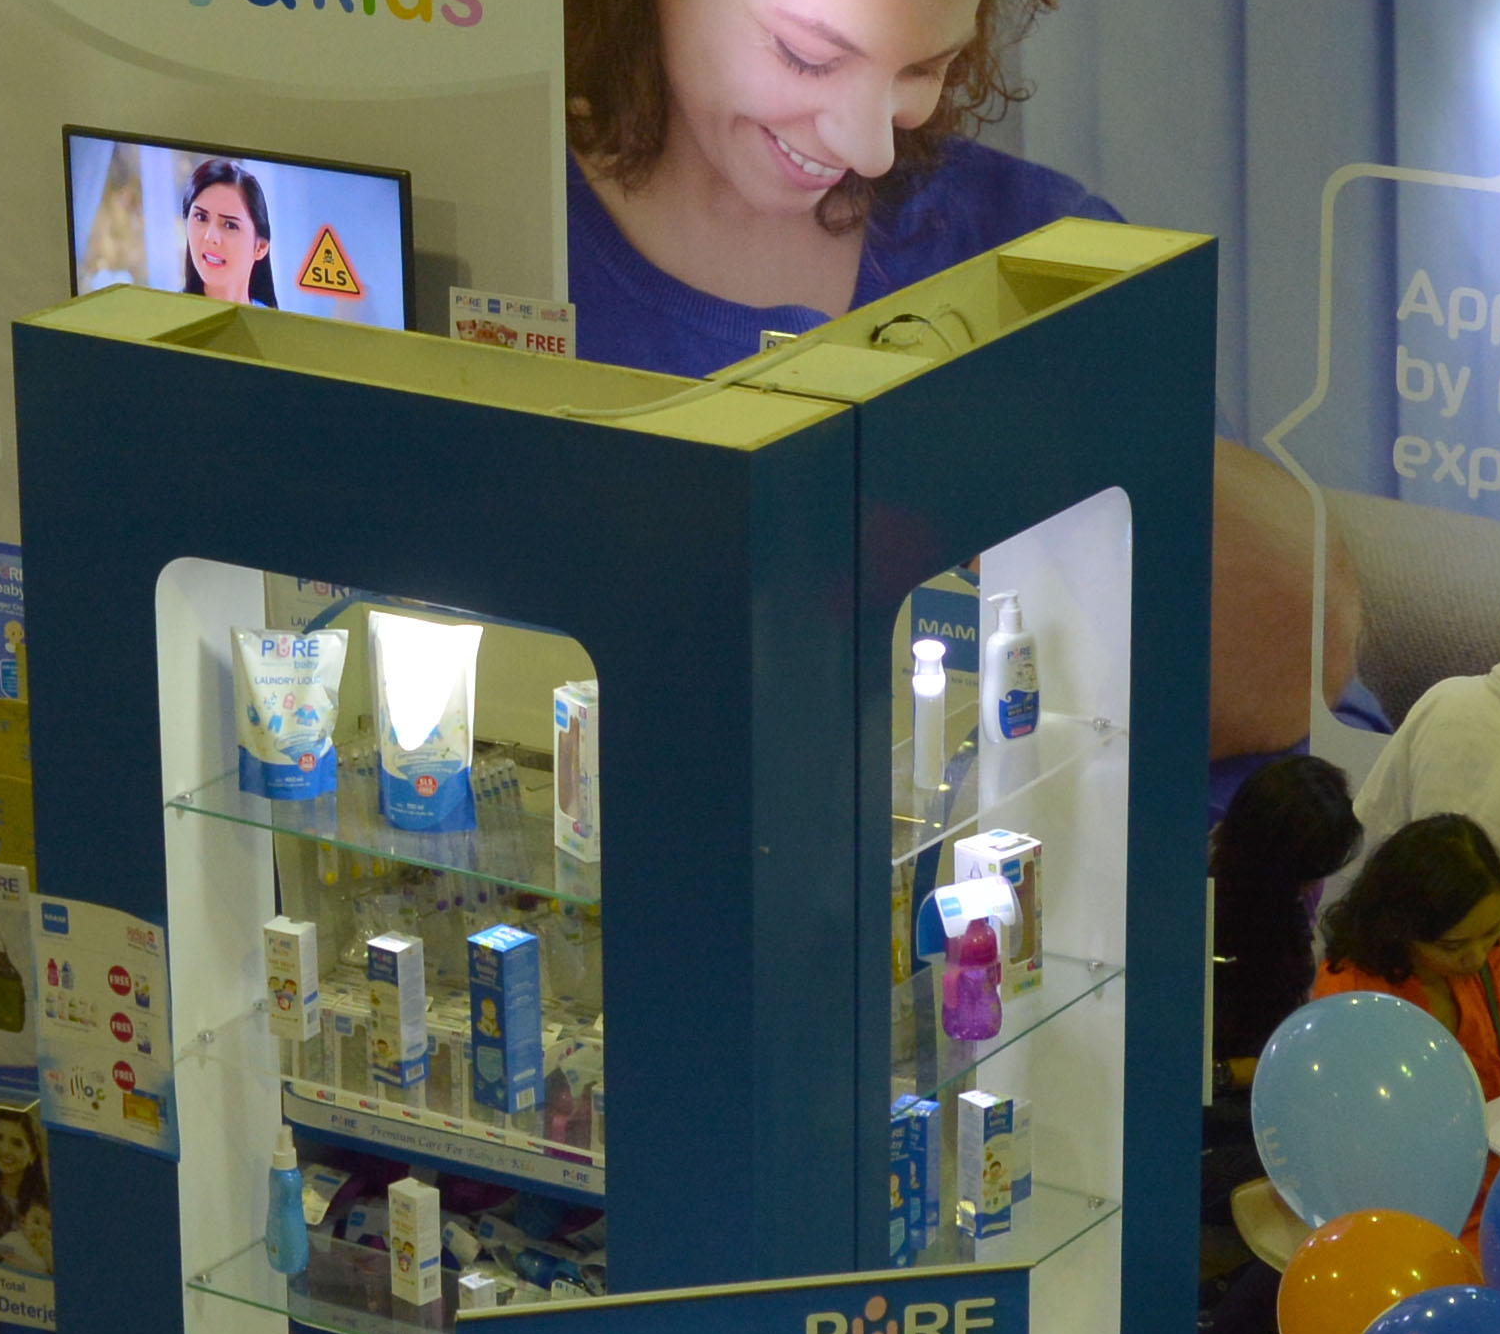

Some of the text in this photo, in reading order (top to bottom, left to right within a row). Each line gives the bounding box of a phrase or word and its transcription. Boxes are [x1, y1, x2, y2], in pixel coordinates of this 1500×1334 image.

[311, 264, 349, 291] SLS
[526, 332, 566, 354] FREE
[1396, 344, 1471, 420] by
[918, 618, 976, 642] MAM
[261, 637, 320, 660] PURE
[0, 1278, 26, 1293] Total
